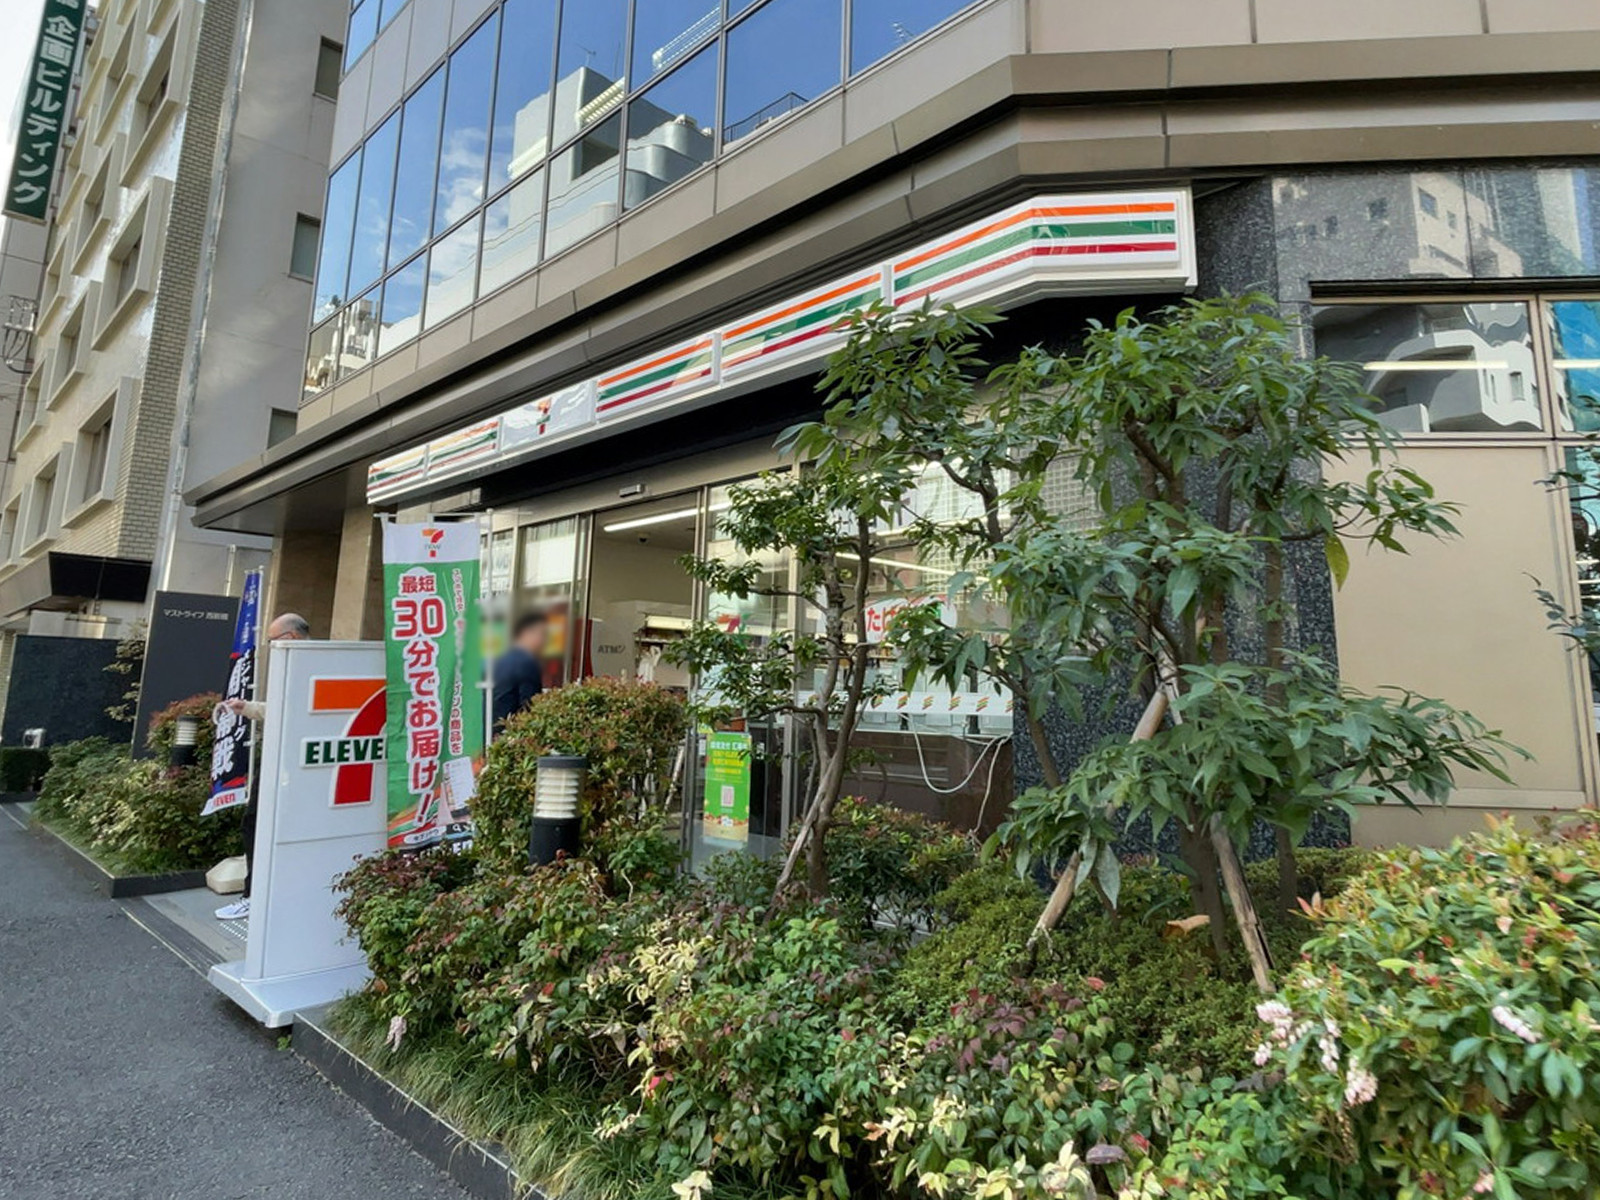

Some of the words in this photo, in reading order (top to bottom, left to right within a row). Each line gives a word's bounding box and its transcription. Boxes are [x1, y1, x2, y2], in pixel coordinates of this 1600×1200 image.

[233, 649, 252, 742] メジャーーグ
[306, 738, 387, 765] ELEVE
